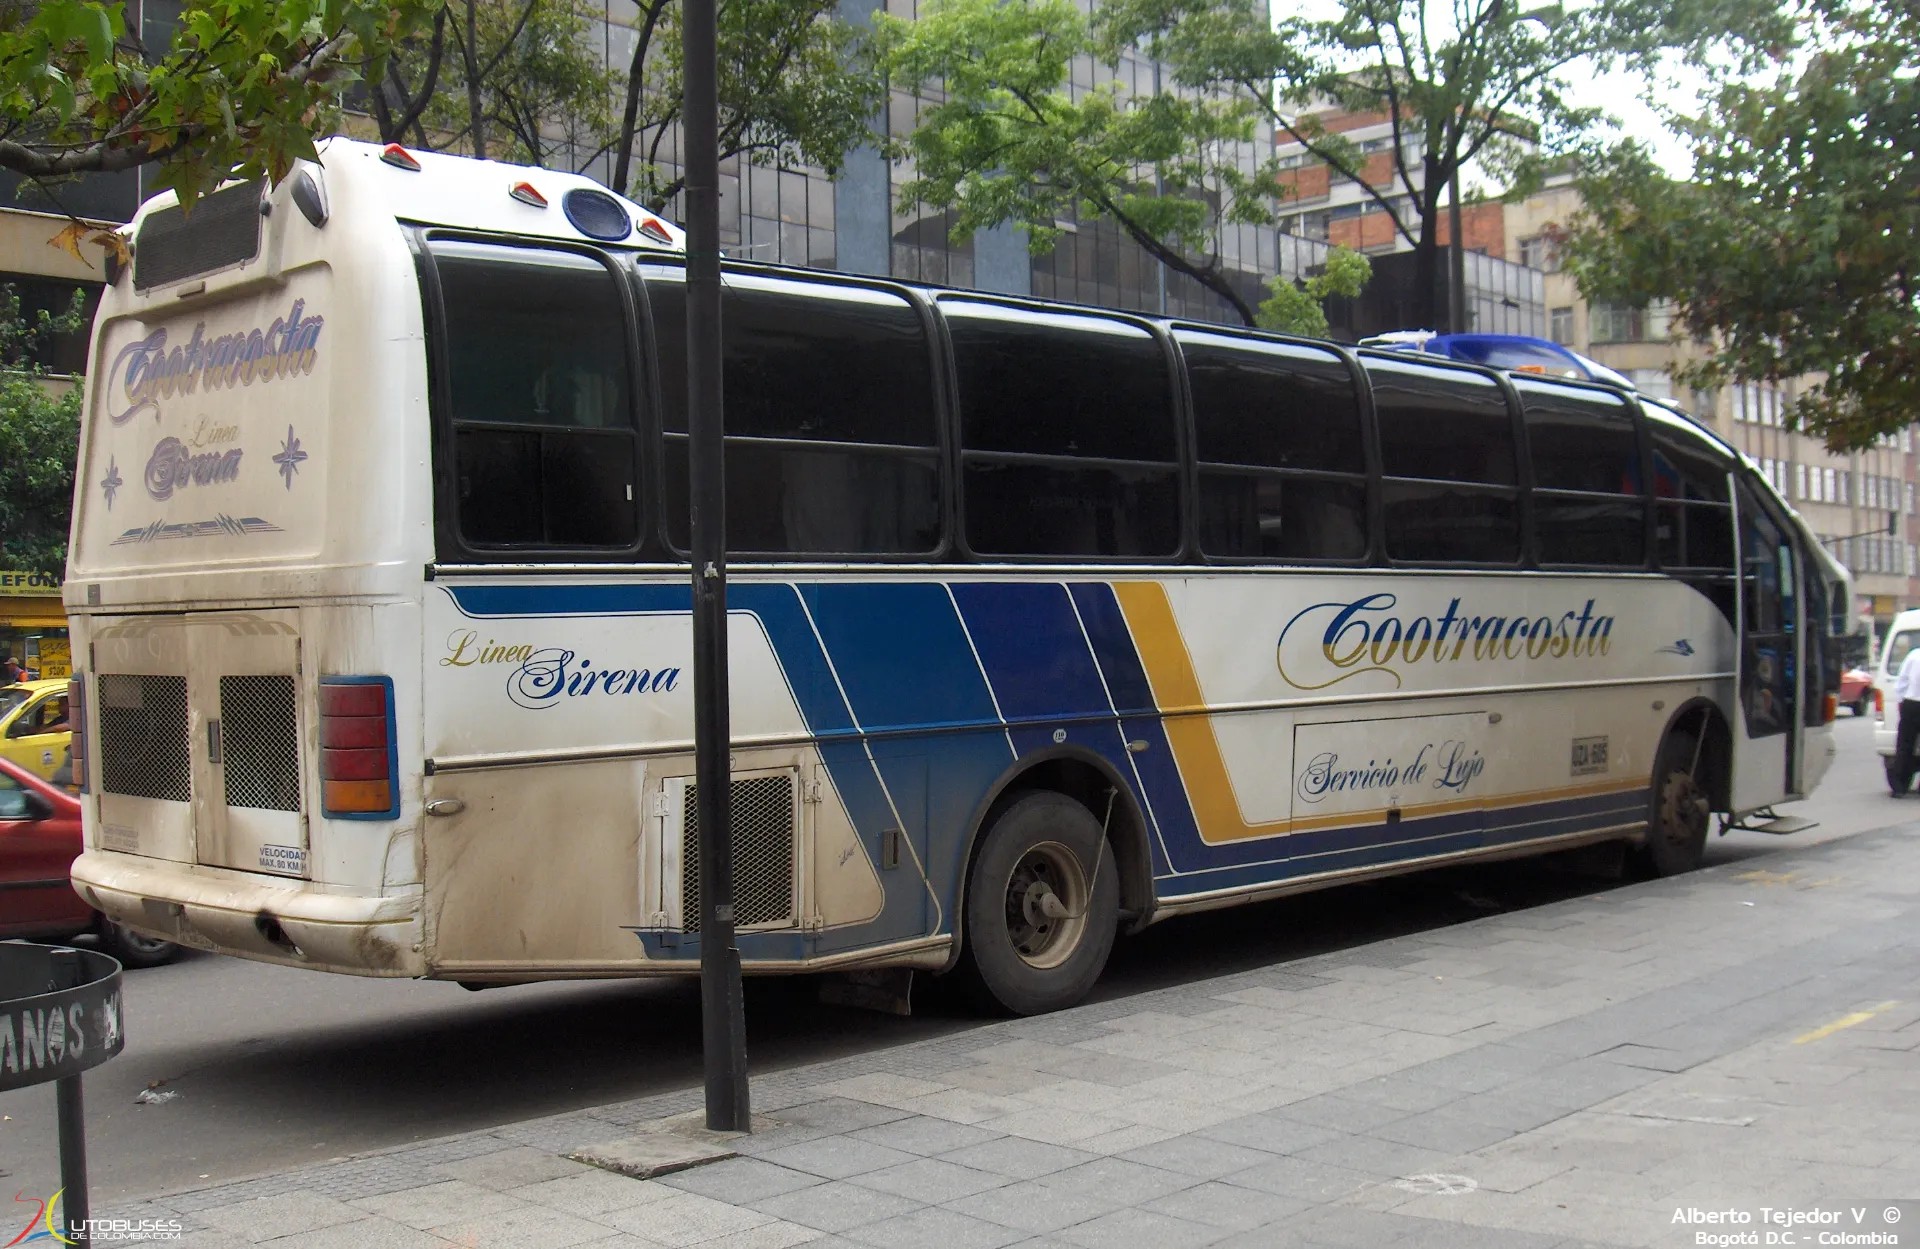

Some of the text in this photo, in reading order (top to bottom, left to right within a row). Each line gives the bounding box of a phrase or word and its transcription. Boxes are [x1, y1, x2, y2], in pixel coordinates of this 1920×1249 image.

[106, 297, 325, 427] Cootracosta
[144, 436, 243, 502] Sirena
[439, 628, 533, 667] Linea
[1277, 593, 1615, 690] Cootracosta
[507, 647, 681, 710] Sirena
[1298, 739, 1485, 804] Servicio de Lujo
[260, 847, 307, 860] VELOCIDAD
